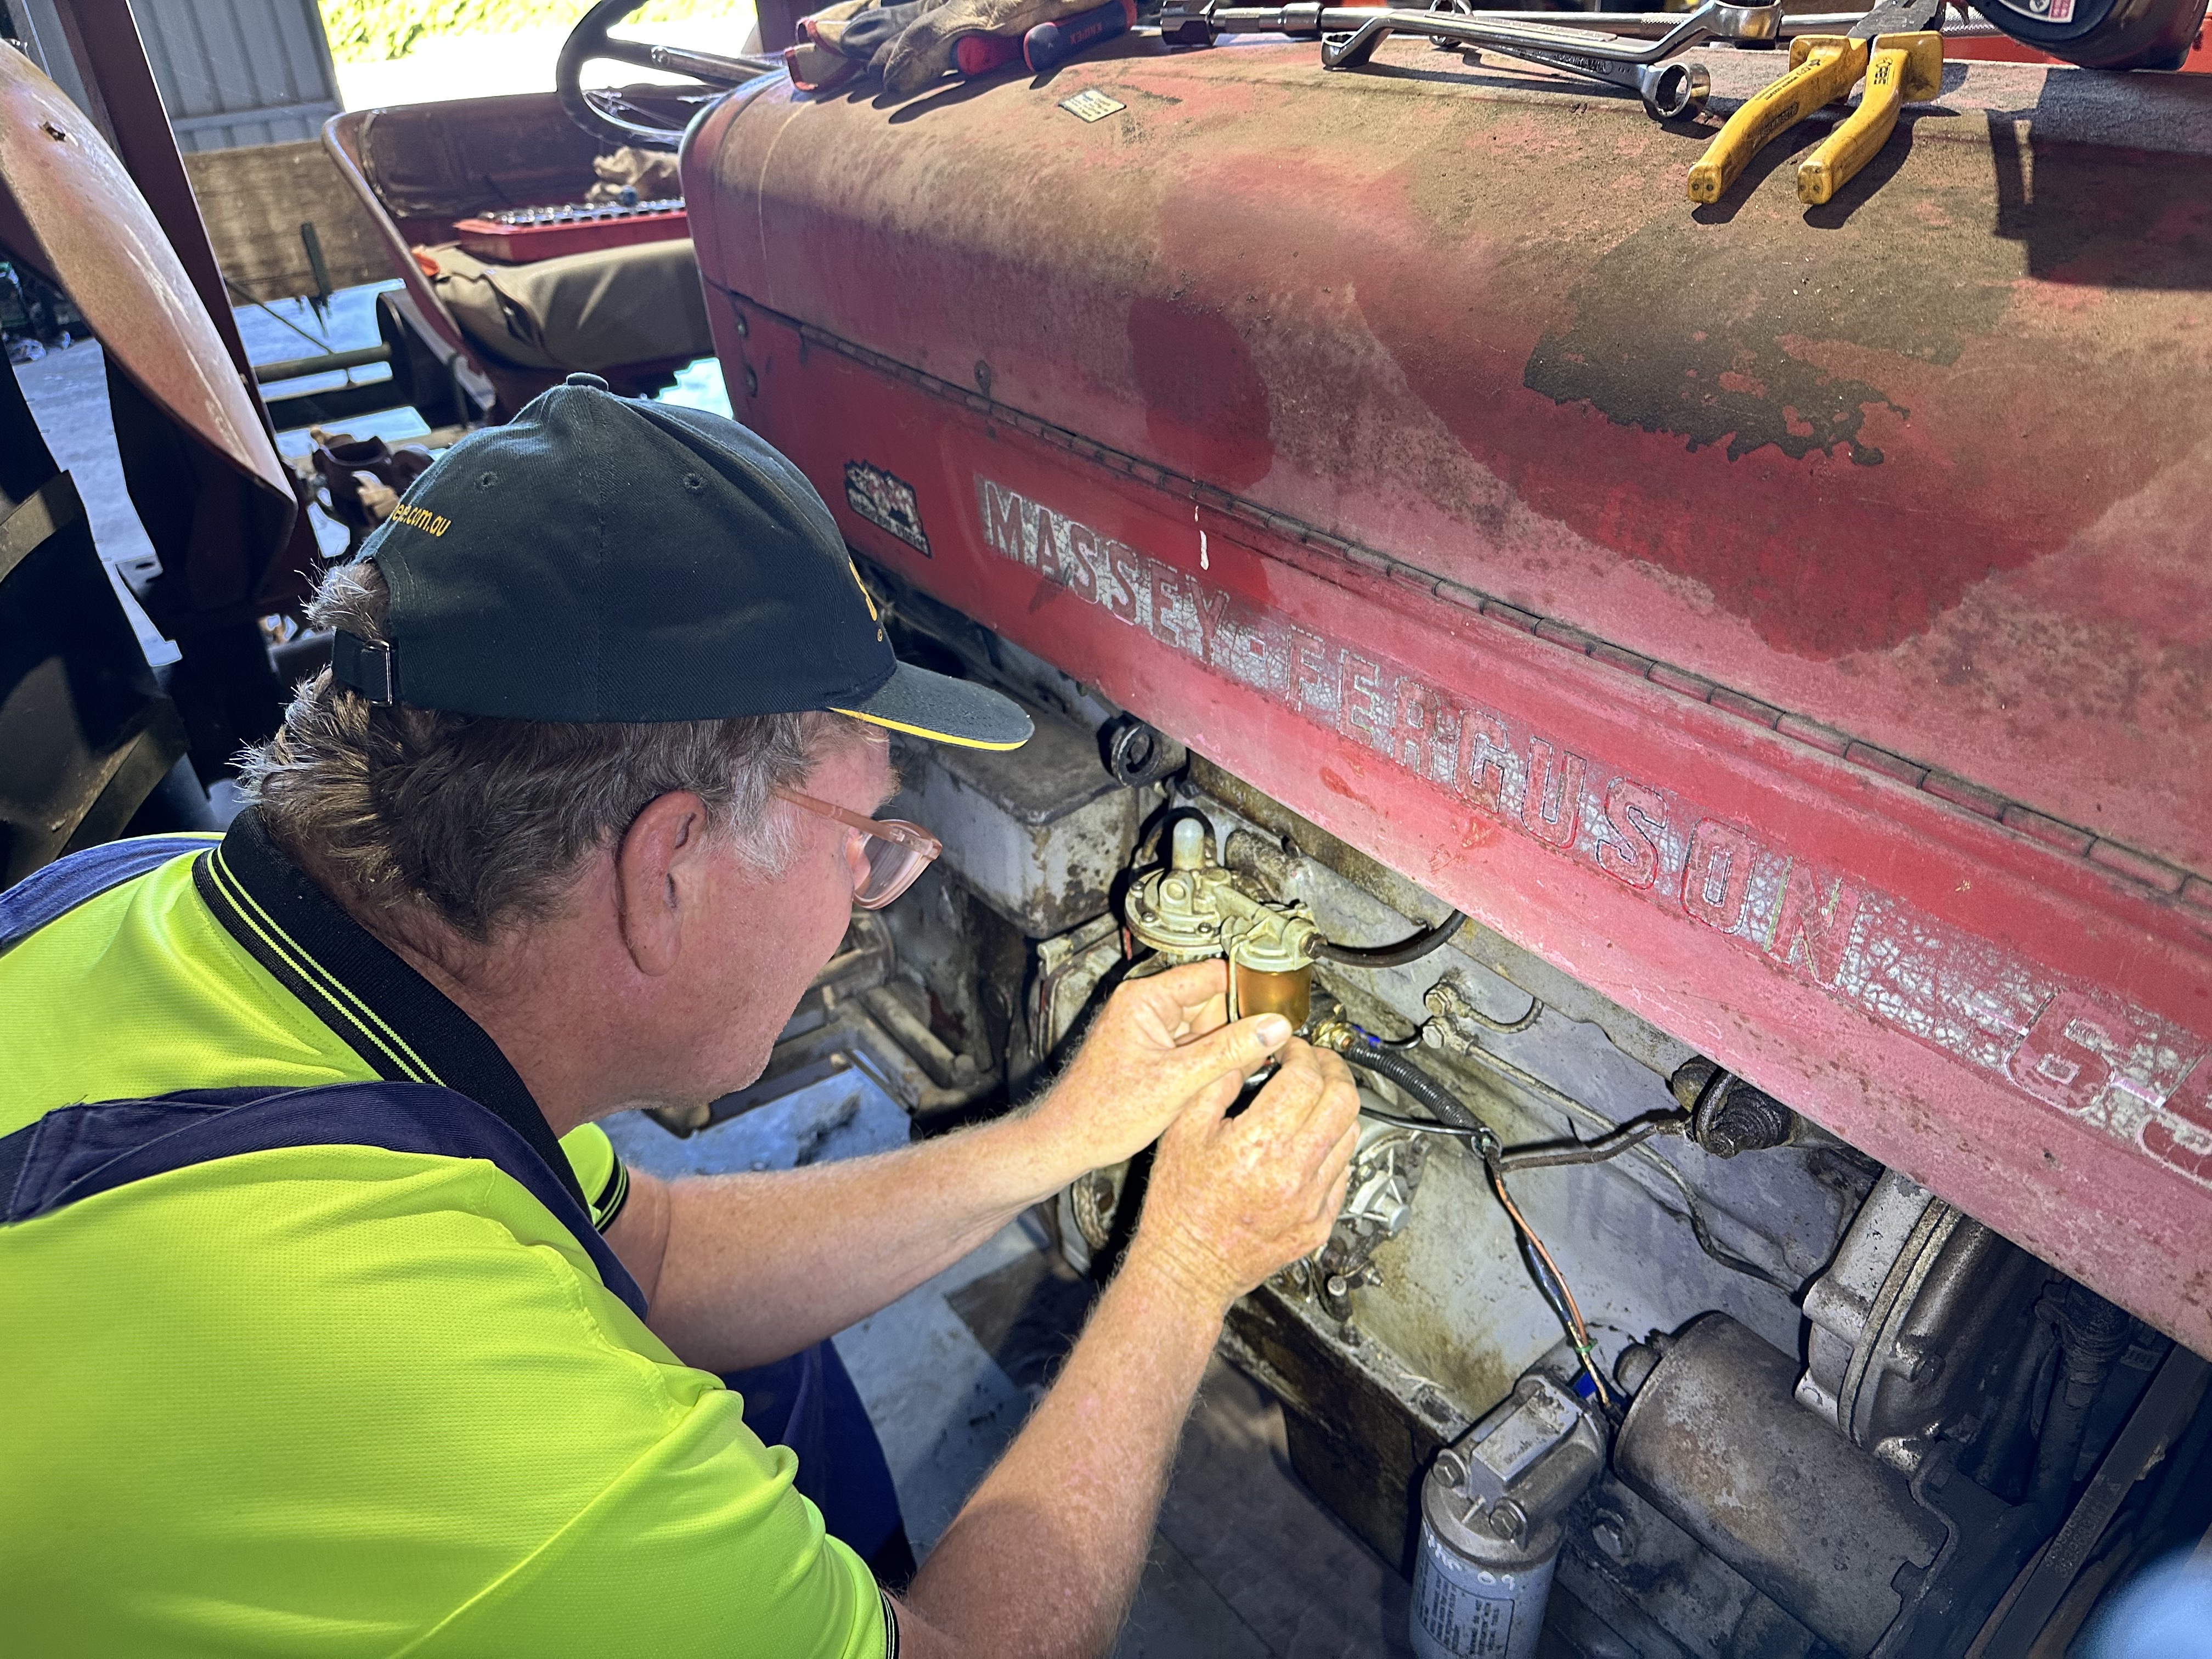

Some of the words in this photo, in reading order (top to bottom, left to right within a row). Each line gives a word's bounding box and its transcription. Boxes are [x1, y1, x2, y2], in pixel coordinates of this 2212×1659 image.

[1069, 22, 1103, 45] KNIPEX
[390, 503, 452, 538] ee.com.au
[986, 479, 1230, 666] MASSEY
[1285, 622, 1865, 994] FERGUSON
